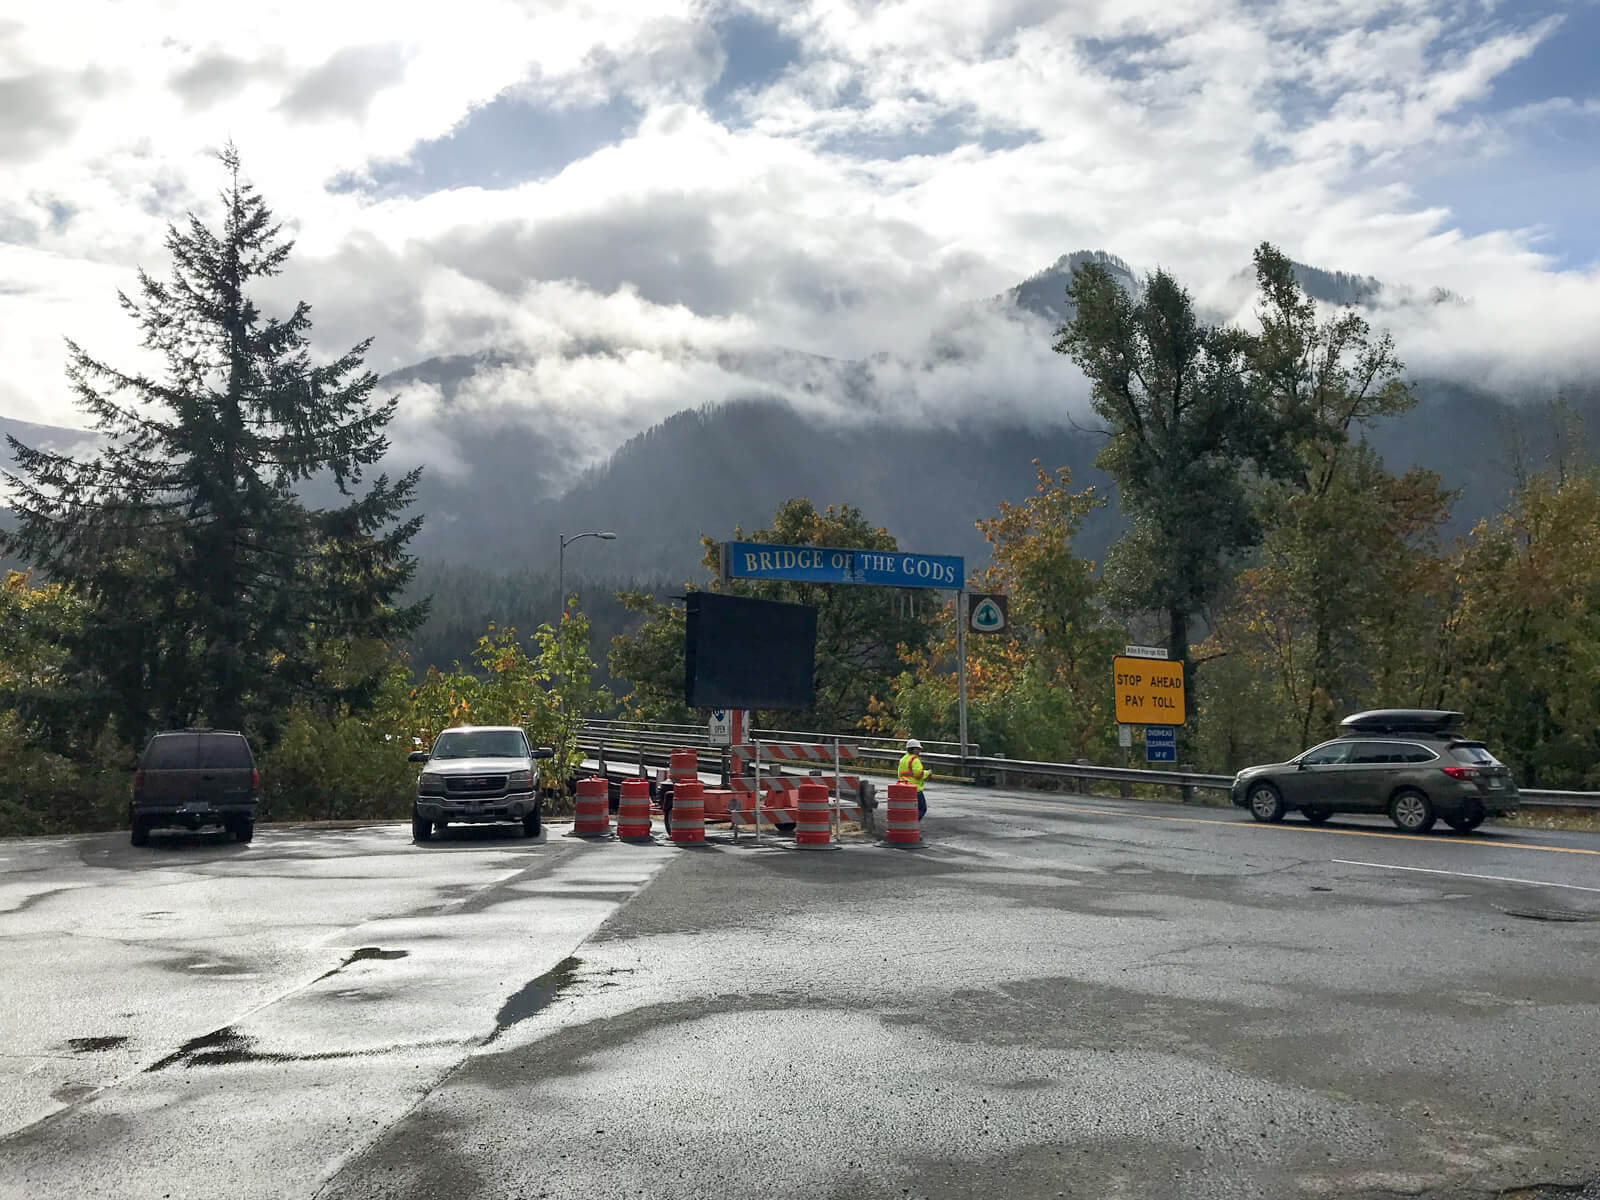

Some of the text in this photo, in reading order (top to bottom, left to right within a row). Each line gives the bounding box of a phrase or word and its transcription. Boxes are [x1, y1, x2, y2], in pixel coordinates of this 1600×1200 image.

[744, 550, 954, 583] BRIDGE OF THE GODS
[1117, 674, 1181, 688] STOP AHEAD
[1125, 695, 1175, 708] PAY TOLL
